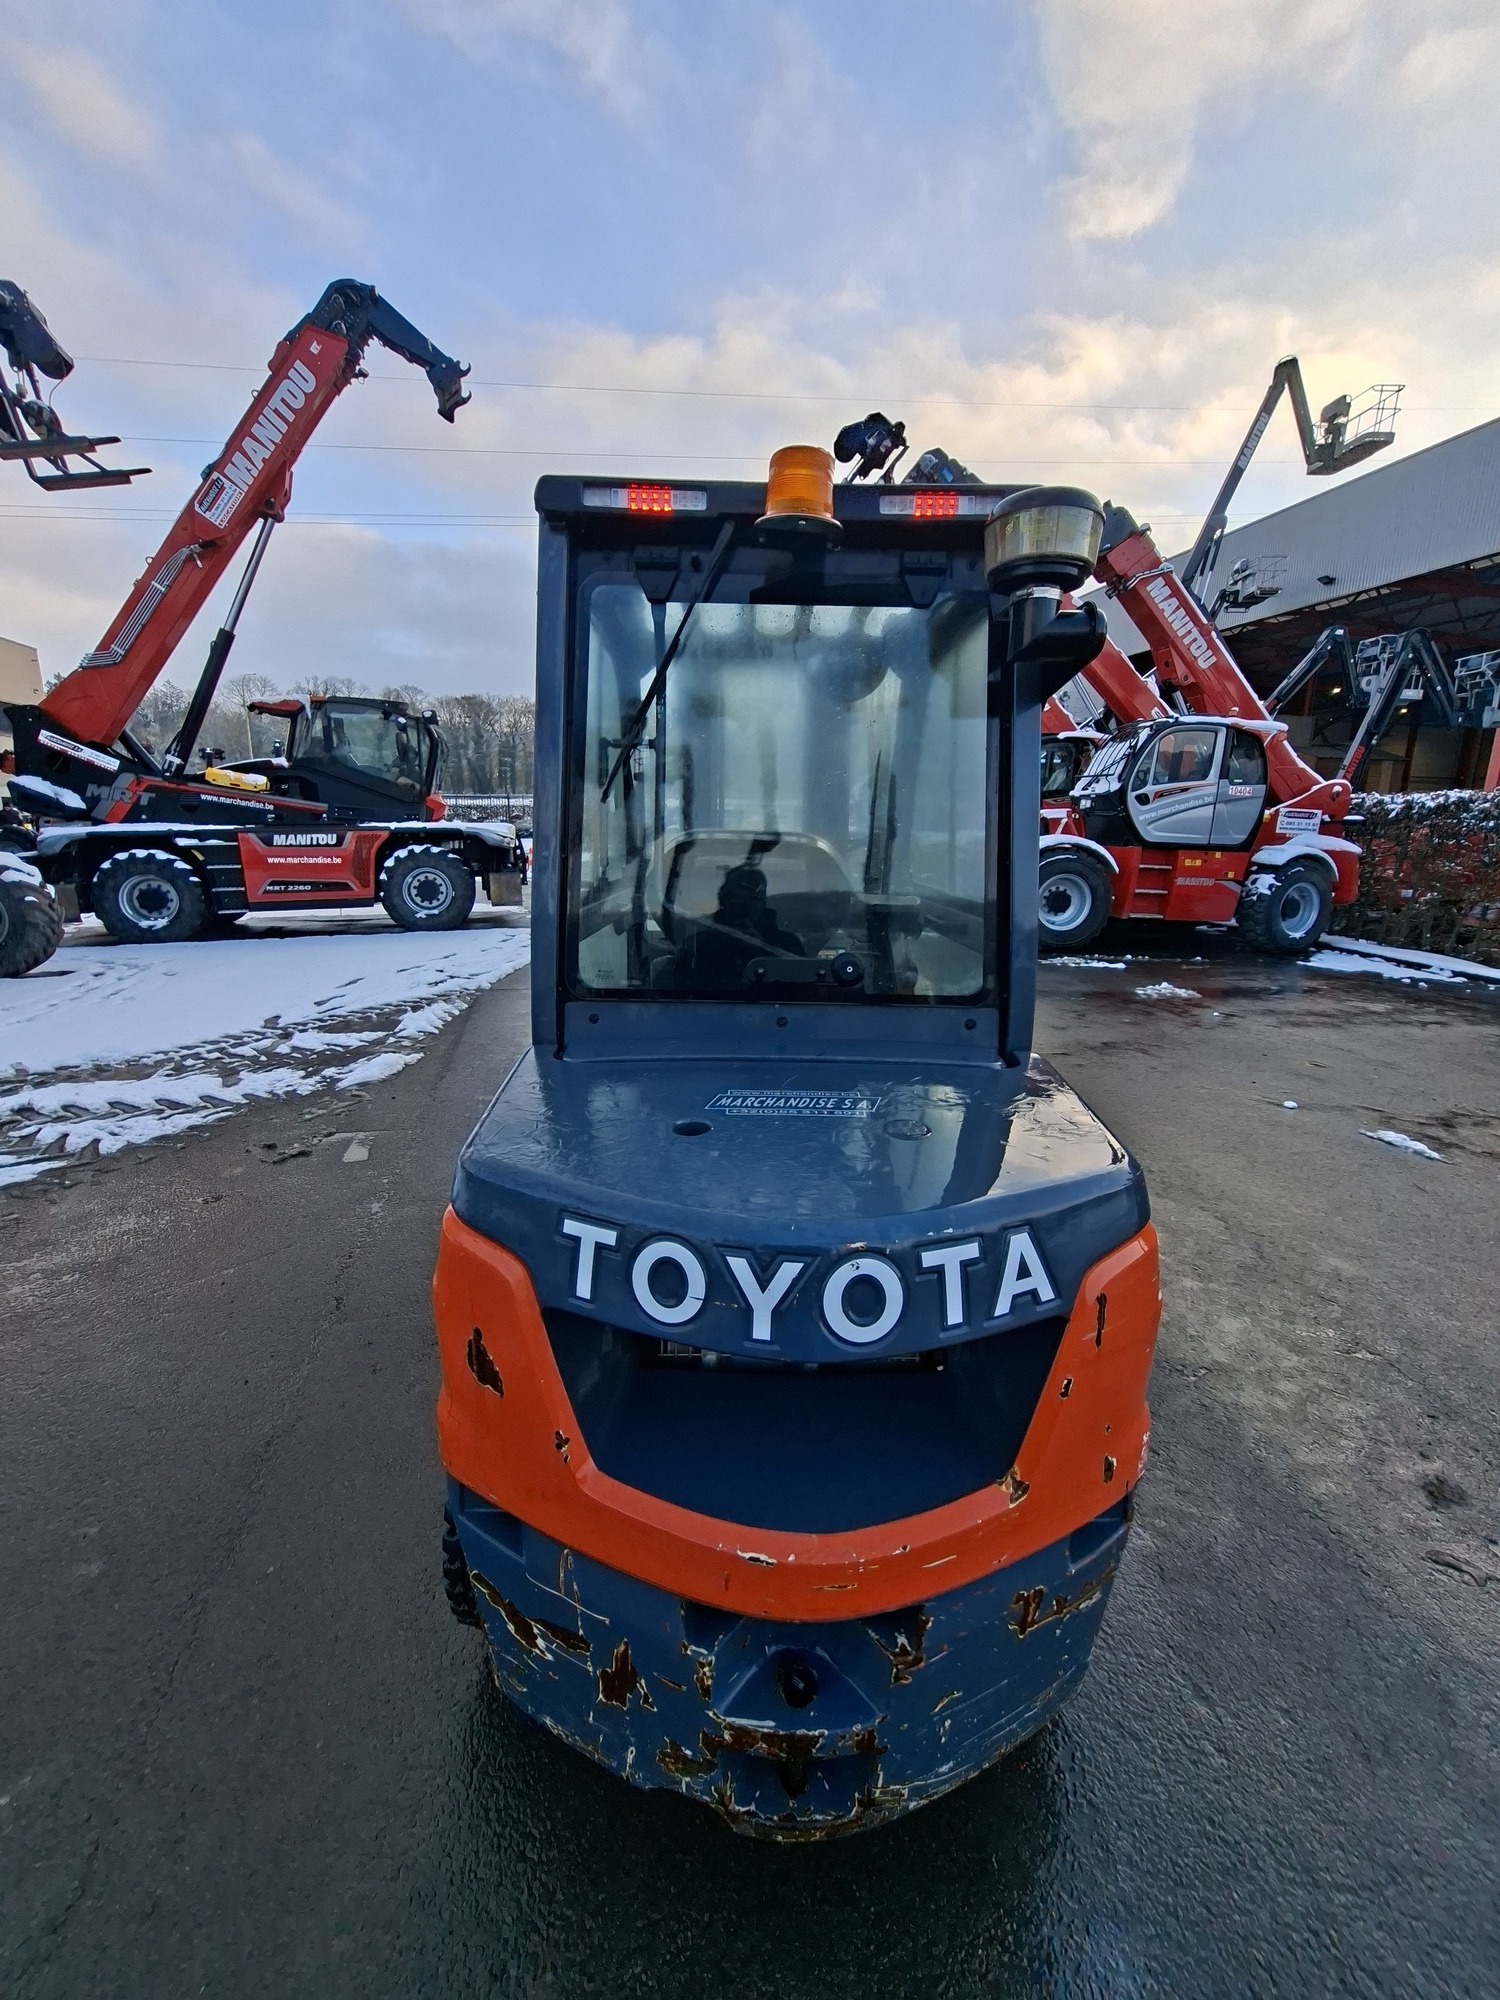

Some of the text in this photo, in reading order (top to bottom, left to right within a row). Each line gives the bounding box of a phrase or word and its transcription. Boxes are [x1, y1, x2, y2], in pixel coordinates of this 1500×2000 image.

[223, 358, 317, 493] MANITOU
[1237, 411, 1269, 470] MANITOU
[219, 492, 243, 525] LOCATION
[1145, 576, 1218, 670] MANITOU
[1343, 744, 1367, 780] ANITOU
[85, 783, 157, 806] MRT
[200, 793, 275, 811] www.marchandise.be
[1138, 795, 1215, 822] www.marchandise.be
[273, 833, 338, 846] MANITOU
[266, 855, 343, 864] www.marchandise.be
[1175, 877, 1216, 886] MANITOU
[716, 1097, 839, 1109] MARCHANDISE
[562, 1218, 1056, 1344] TOYOTA
